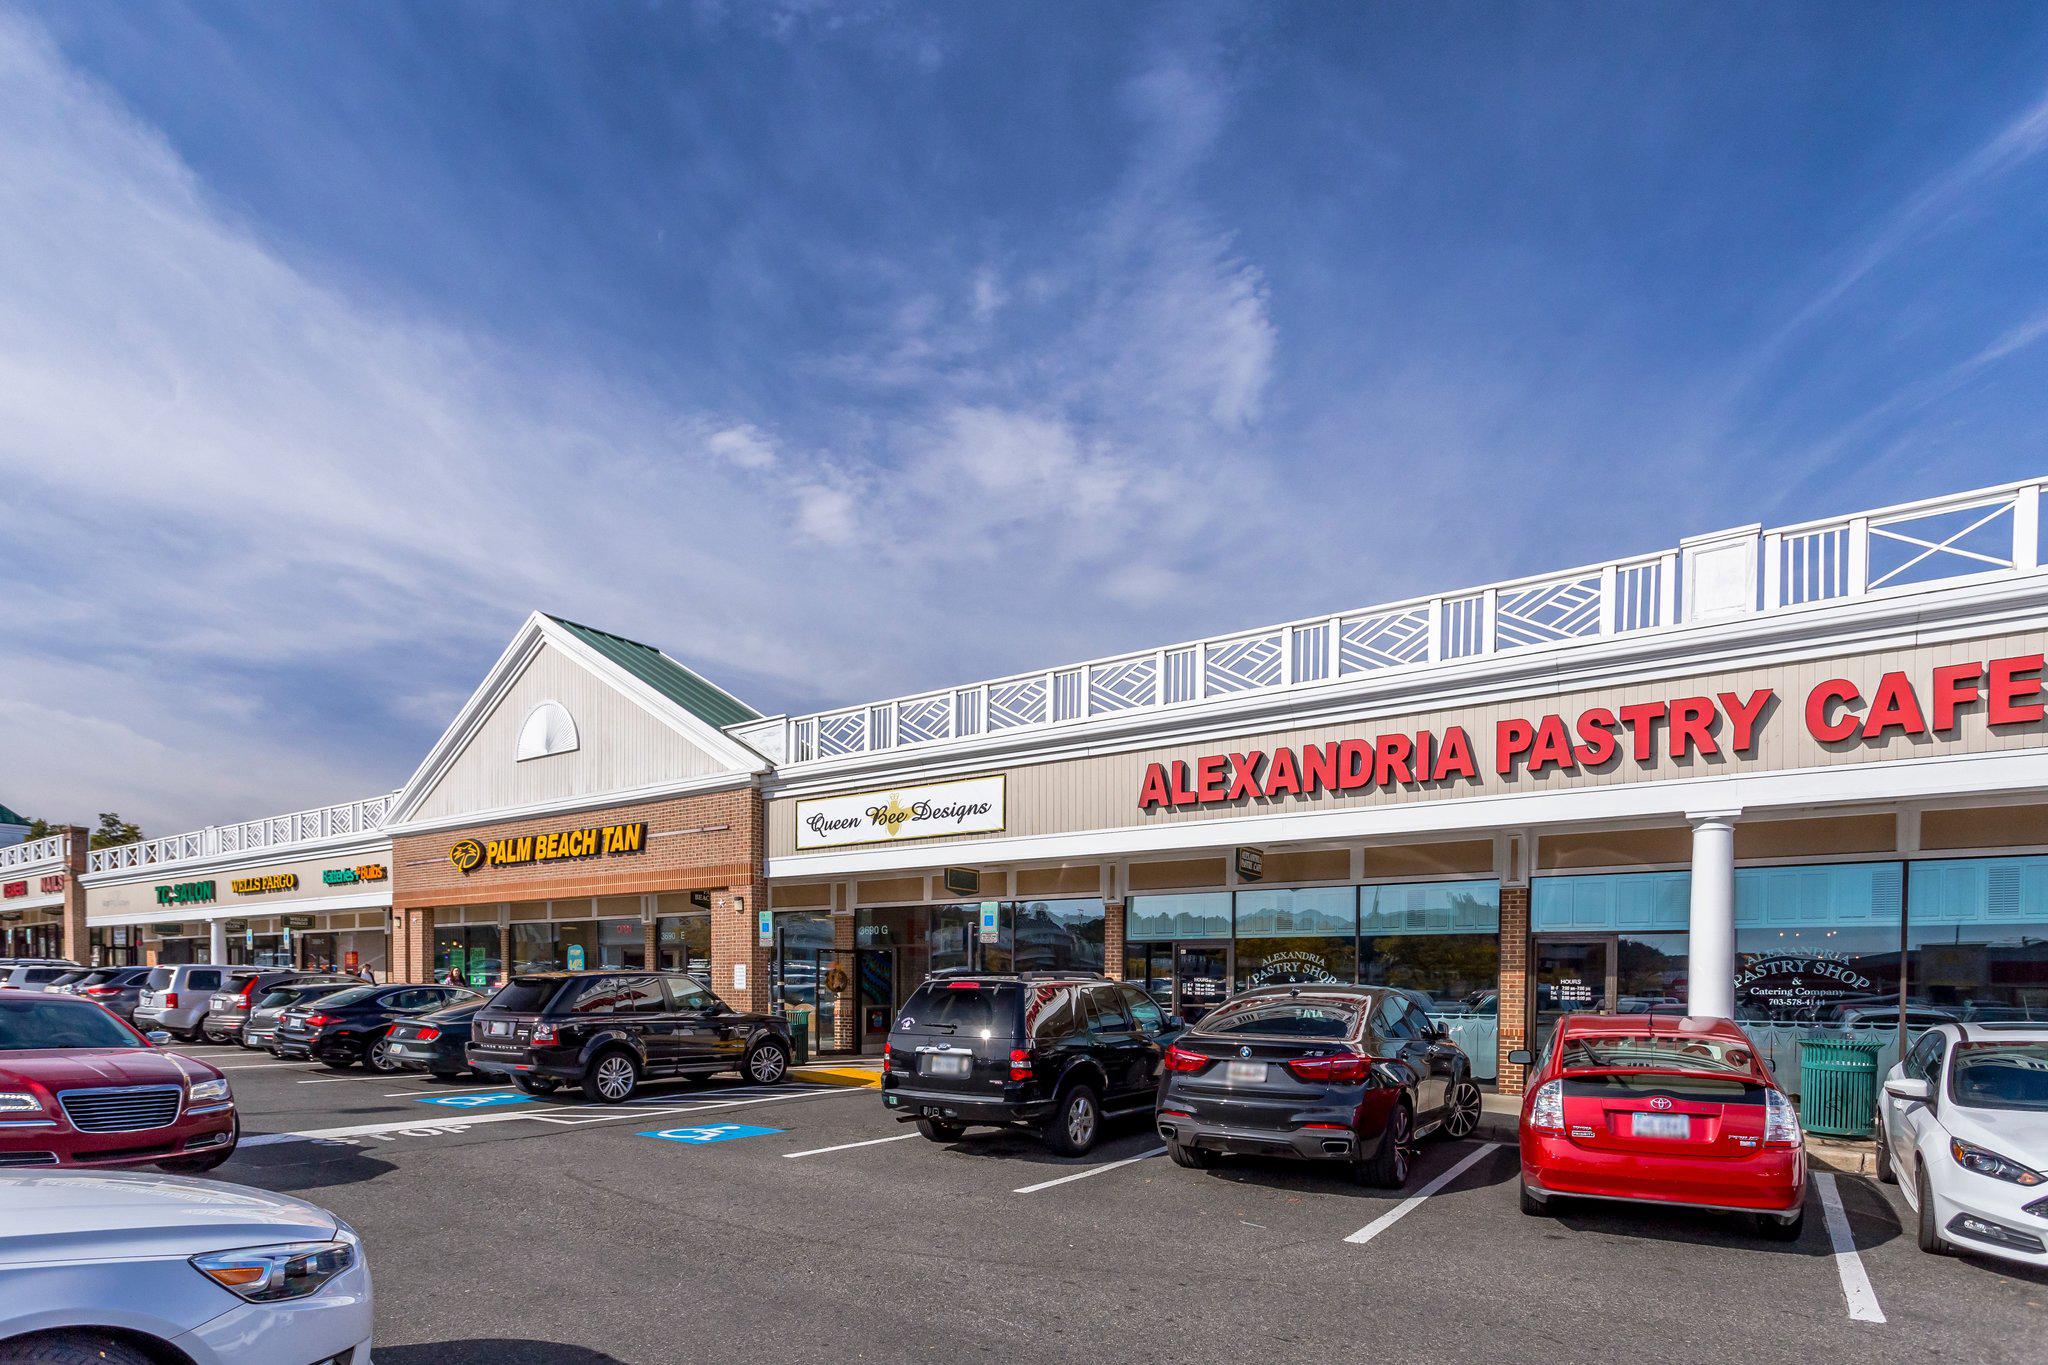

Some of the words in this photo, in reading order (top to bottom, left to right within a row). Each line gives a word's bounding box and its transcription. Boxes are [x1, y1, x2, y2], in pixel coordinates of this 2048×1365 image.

[1139, 726, 1475, 807] ALEXANDRIA
[1495, 688, 1773, 773] PASTRY
[1805, 653, 2045, 742] CAFE
[806, 812, 862, 838] Queen
[865, 806, 909, 826] Bee
[911, 799, 992, 823] Designs
[487, 836, 532, 865] PALM
[535, 829, 598, 860] BEACH
[602, 823, 642, 853] TAN
[173, 880, 214, 903] SALON
[231, 878, 261, 894] WELLS
[261, 873, 296, 890] FARGO
[661, 931, 676, 941] 3690
[680, 931, 685, 940] E
[1261, 950, 1326, 967] ALEXANDRIA
[1744, 946, 1851, 967] ALEXANDRIA
[1250, 962, 1300, 984] PASTRY
[1302, 964, 1338, 985] SHOP
[1289, 975, 1296, 983] &
[1733, 960, 1811, 989] PASTRY
[1813, 961, 1871, 989] SHOP
[1791, 976, 1802, 986] &
[1750, 987, 1793, 997] Catering
[1795, 987, 1845, 997] Company
[311, 1124, 472, 1146] STOP
